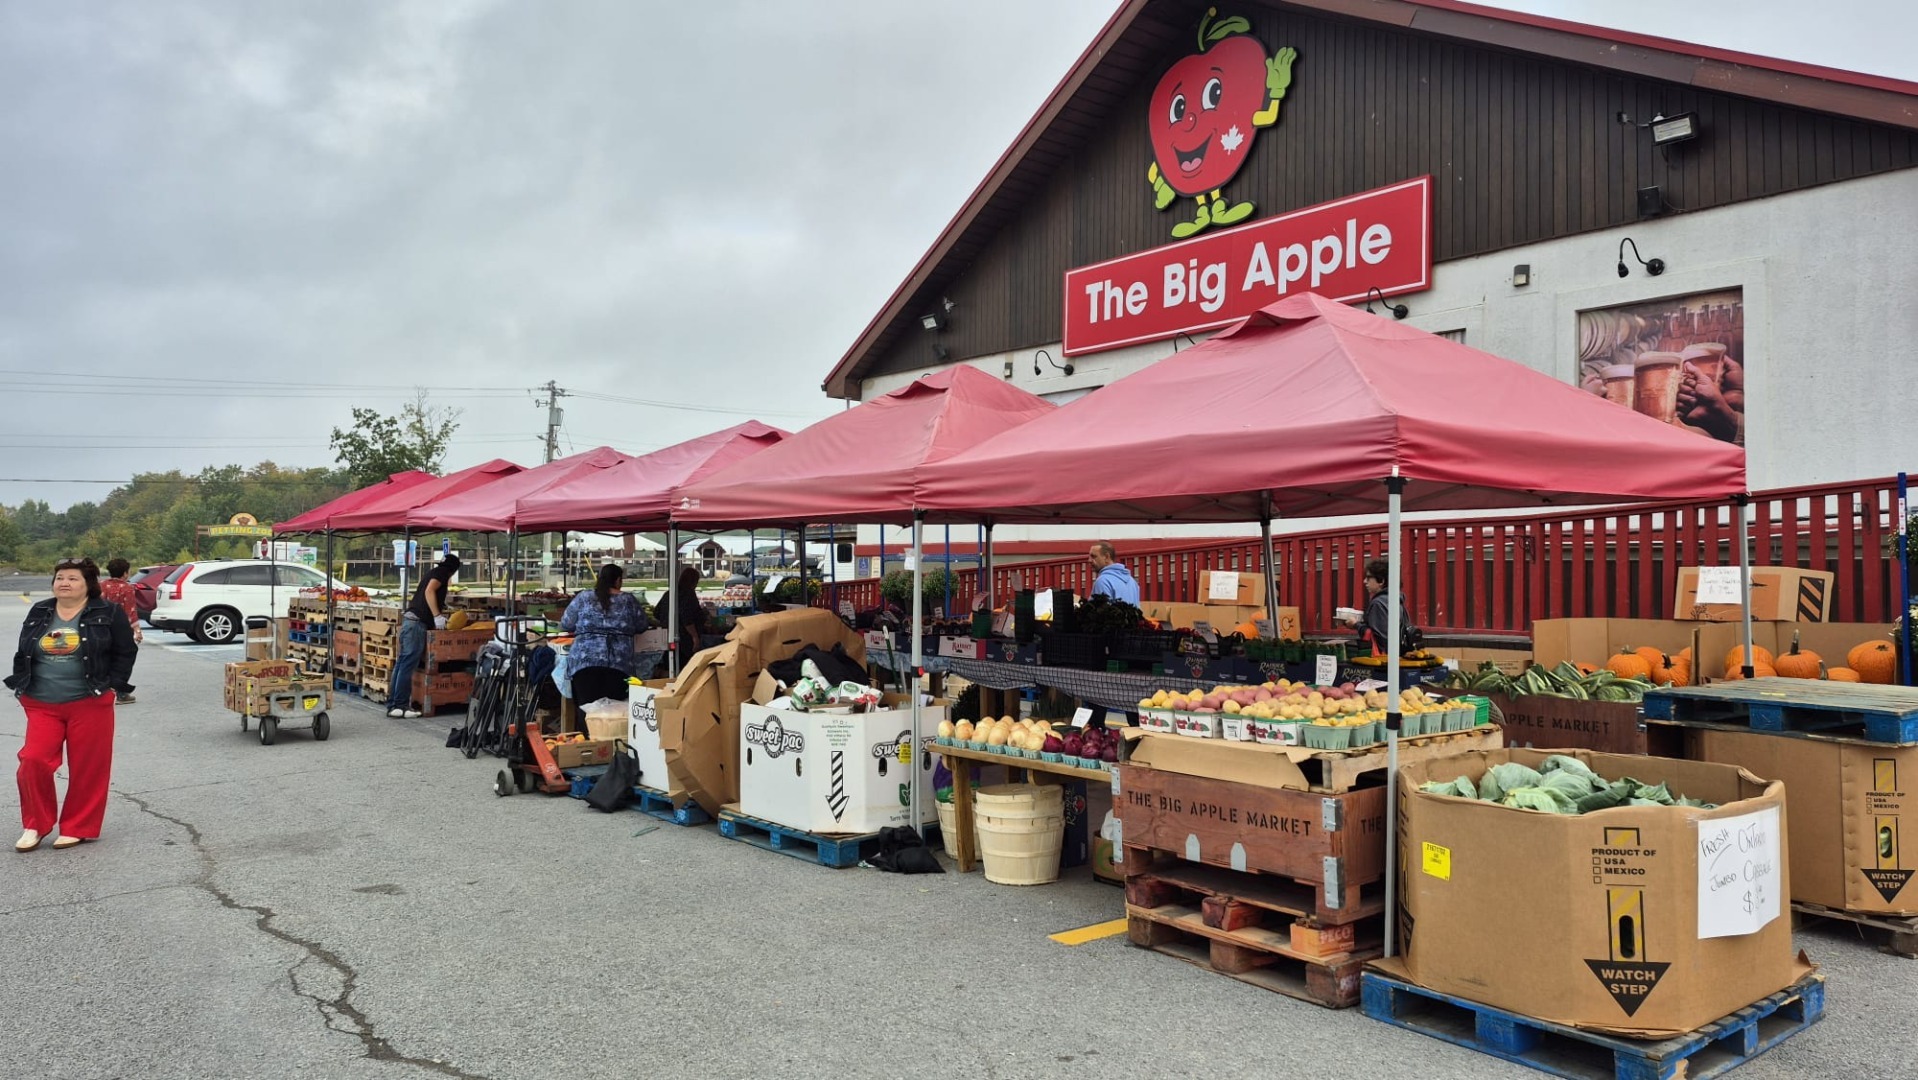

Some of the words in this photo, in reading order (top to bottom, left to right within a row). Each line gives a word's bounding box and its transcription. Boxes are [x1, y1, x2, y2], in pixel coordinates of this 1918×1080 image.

[1085, 279, 1148, 324] The
[1163, 258, 1227, 313] Big
[1241, 217, 1393, 295] Apple
[1552, 717, 1609, 734] MARKET
[1128, 790, 1152, 808] THE
[1159, 796, 1182, 813] BIG
[1190, 801, 1239, 823] APPLE
[1246, 811, 1312, 837] MARKET
[1361, 815, 1382, 835] THE
[1700, 828, 1730, 857] FRESH
[1591, 848, 1641, 856] PRODUCT
[1643, 849, 1657, 857] OF
[1604, 867, 1646, 875] MEXICO
[1877, 881, 1901, 889] STEP
[1600, 968, 1656, 981] WATCH
[1610, 983, 1648, 995] STEP
